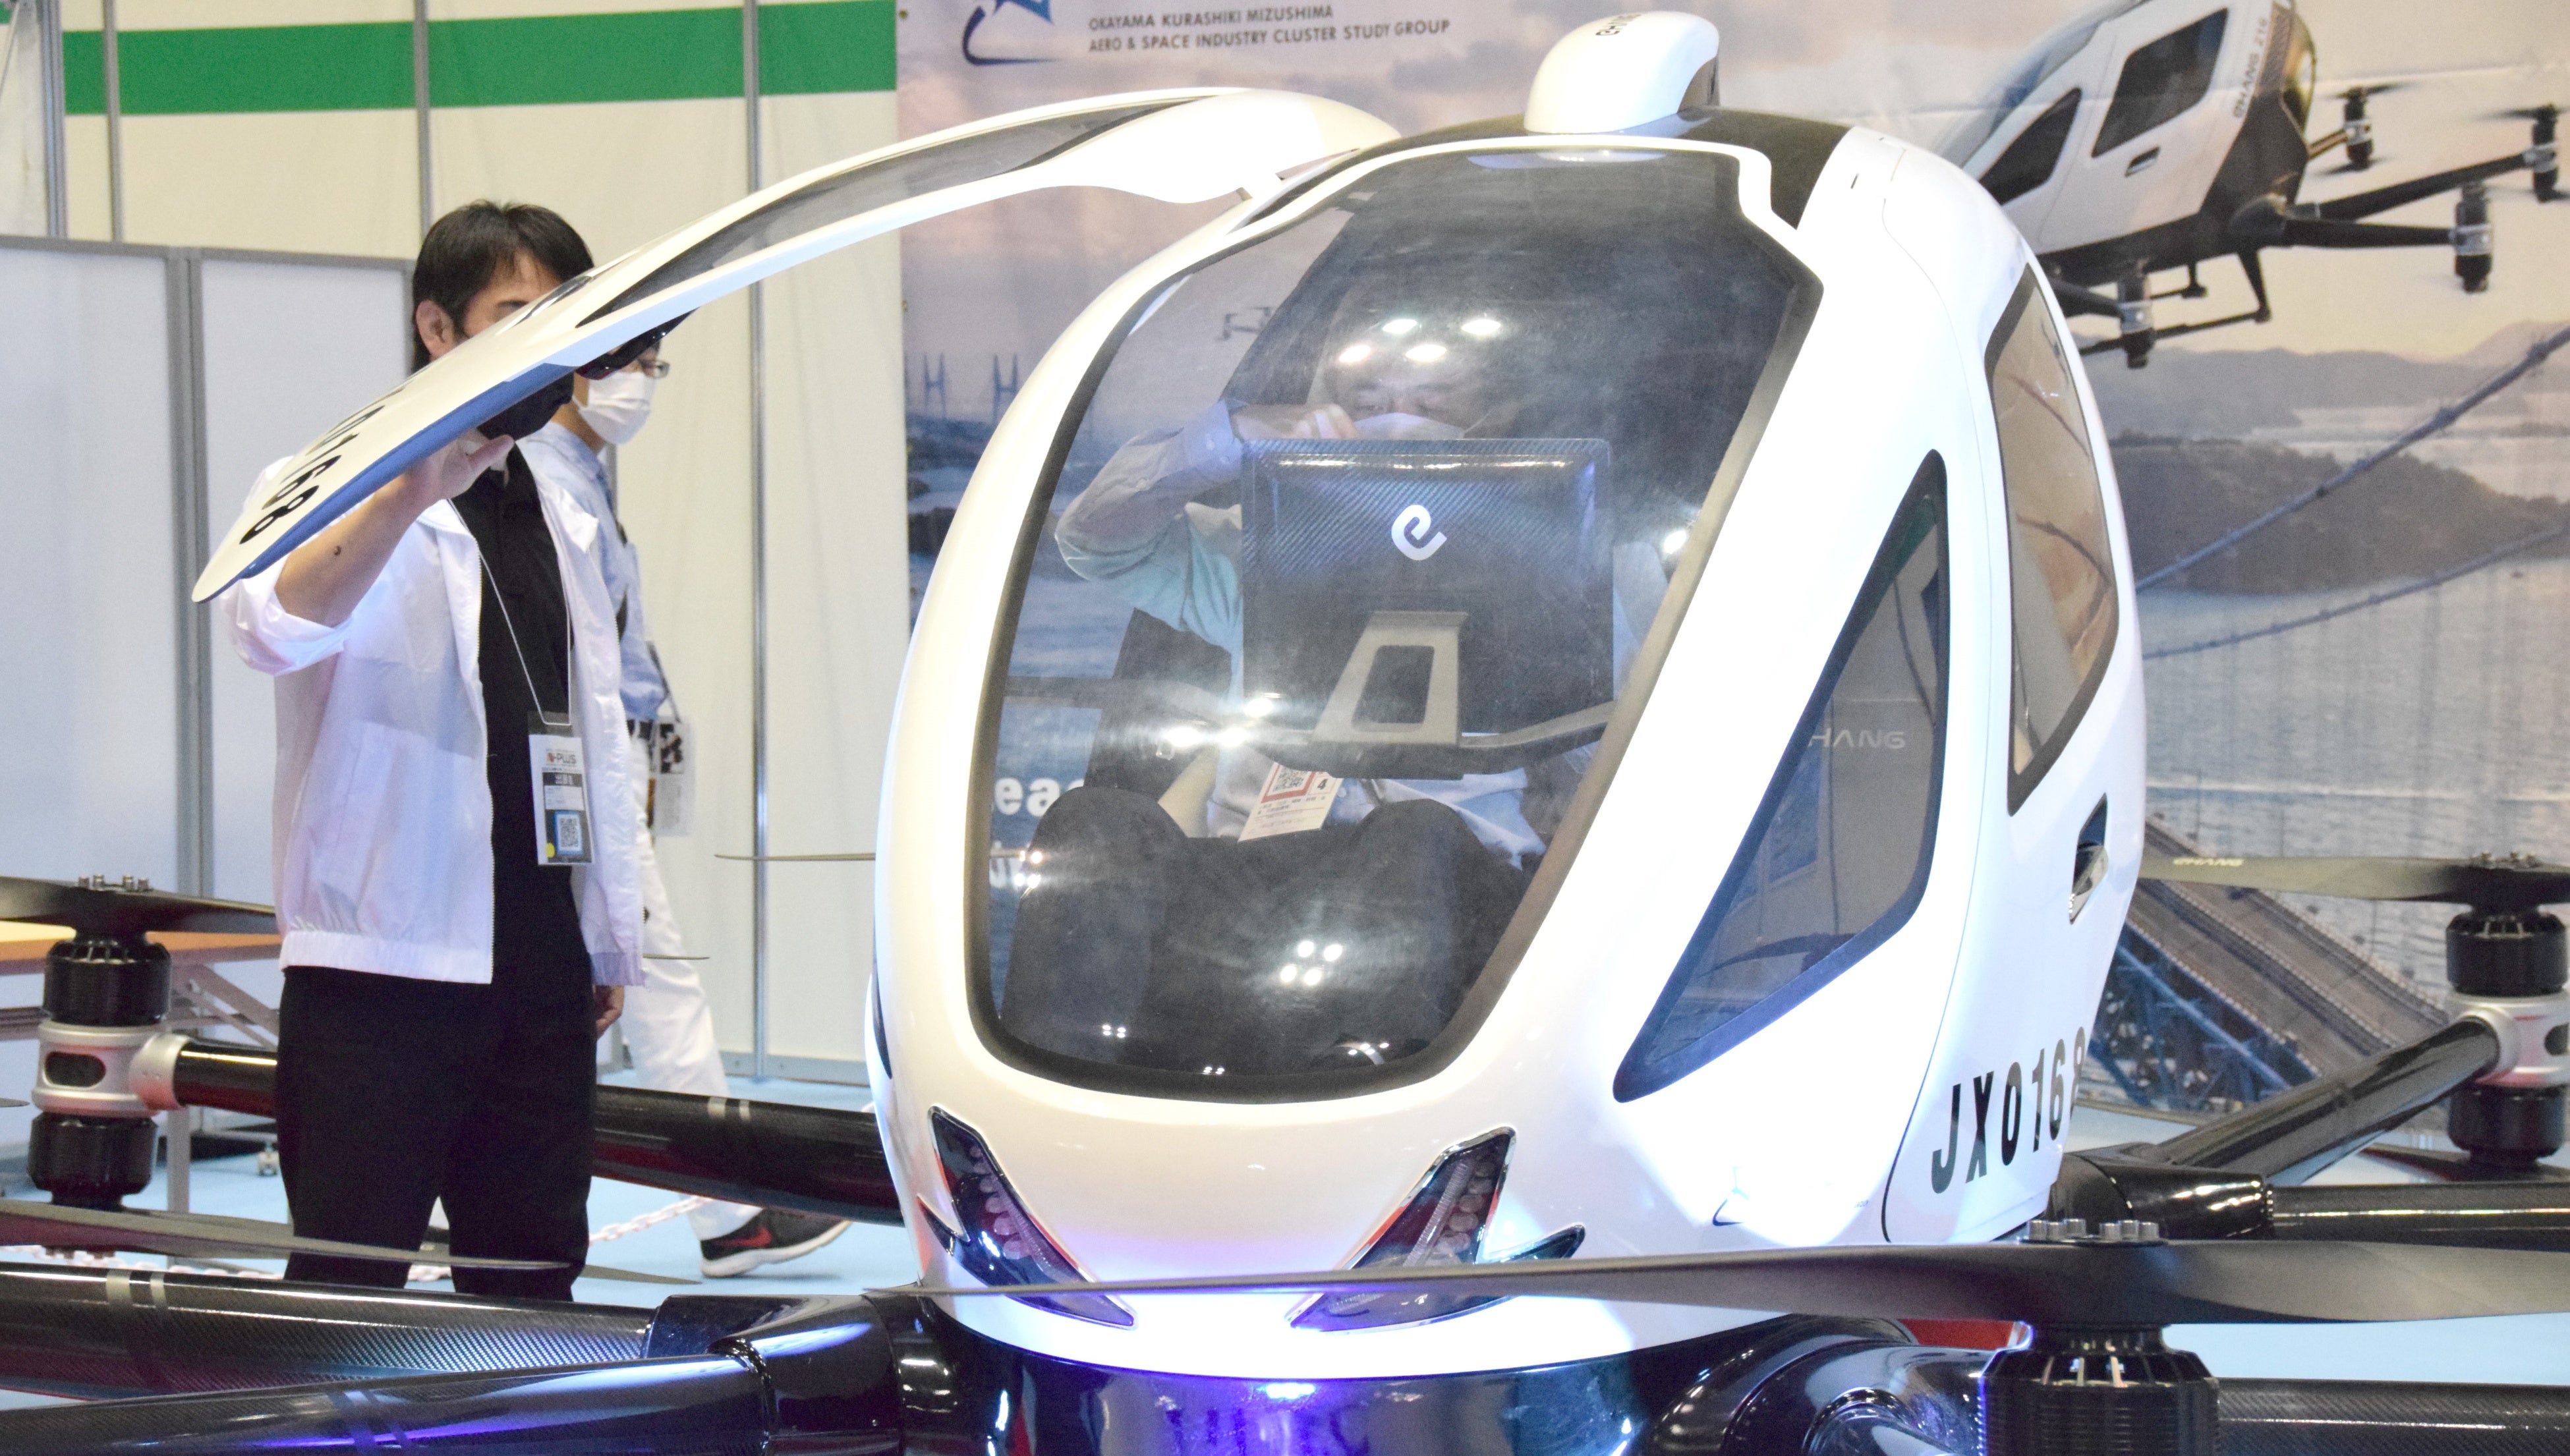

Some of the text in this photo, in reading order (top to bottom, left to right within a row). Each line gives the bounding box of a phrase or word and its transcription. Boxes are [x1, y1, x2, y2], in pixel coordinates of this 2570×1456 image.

[1089, 5, 1333, 30] OKAYAMA KURASHIKI MIZUSHIMA
[1089, 19, 1450, 51] AERO & SPACE INDUSTRY CLUSTER STUDY GROUP
[1317, 779, 1328, 790] 4
